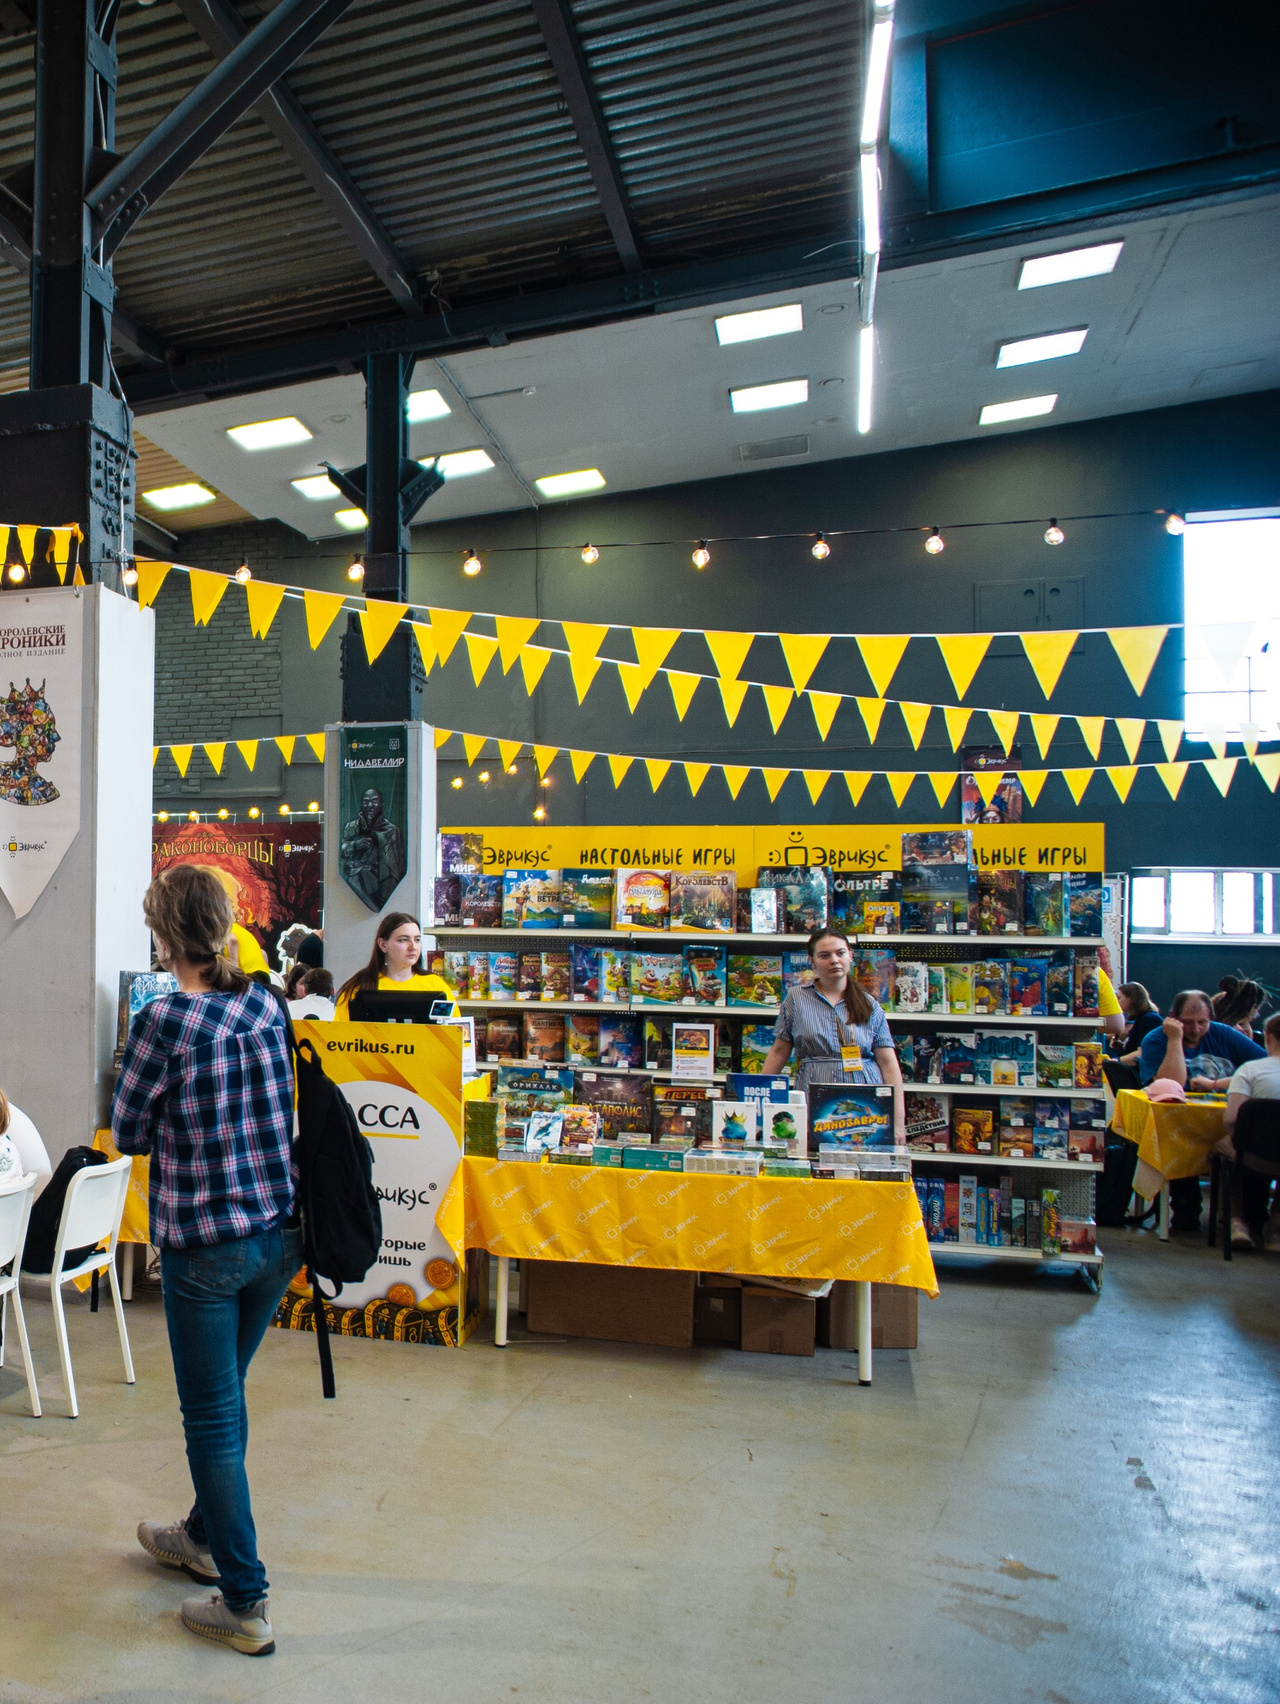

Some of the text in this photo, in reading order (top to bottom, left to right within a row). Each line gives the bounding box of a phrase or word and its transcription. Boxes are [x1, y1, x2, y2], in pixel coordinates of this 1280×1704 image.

[26, 648, 66, 658] ИЗДАНИЕ
[344, 757, 405, 769] НИДАВЕЛЛИР
[152, 839, 274, 867] РАКОНОБОРЦЫ
[580, 847, 683, 866] НАСТОЛЬНЫЕ
[692, 847, 736, 866] ИГРЫ
[1038, 847, 1087, 866] ИГРЫ
[449, 864, 476, 873] МИР
[326, 1038, 415, 1056] evrikus.ru
[744, 1086, 771, 1097] ПОСЛЕ
[357, 1103, 421, 1131] ССА
[583, 1102, 643, 1118] АТАПОЛИС
[813, 1113, 888, 1133] ДИНОЗАВРЫ
